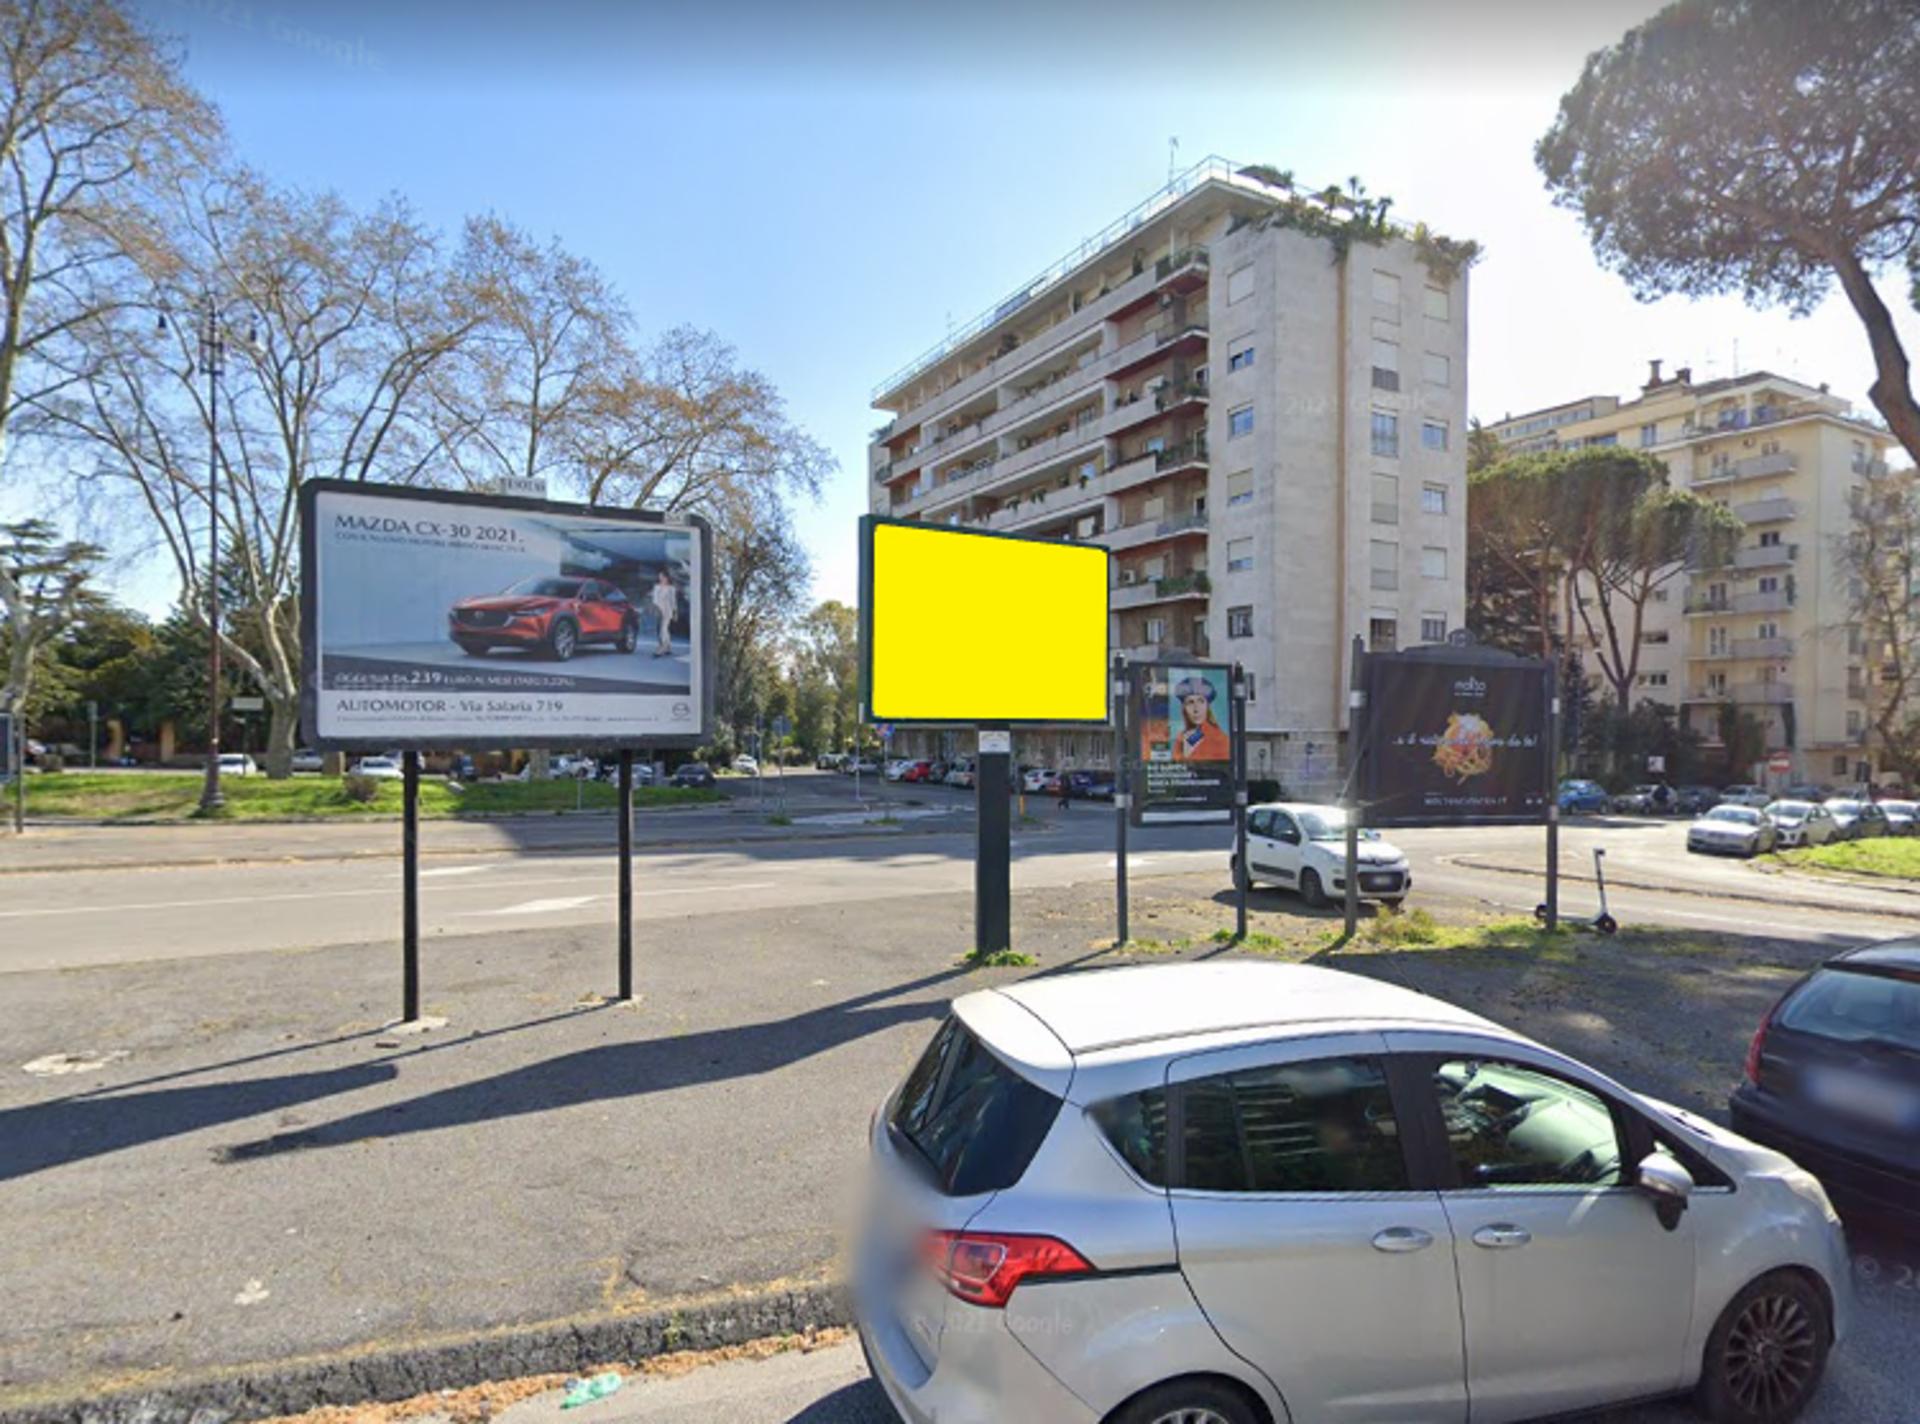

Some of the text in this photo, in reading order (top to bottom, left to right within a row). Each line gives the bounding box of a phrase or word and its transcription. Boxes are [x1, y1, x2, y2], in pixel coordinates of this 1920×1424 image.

[335, 514, 411, 535] MAZDA
[416, 519, 471, 539] CX-30
[410, 670, 442, 684] 239
[336, 699, 446, 712] AUTOMOTOR
[459, 699, 483, 712] Via
[487, 699, 533, 712] Salaria
[537, 699, 563, 712] 719
